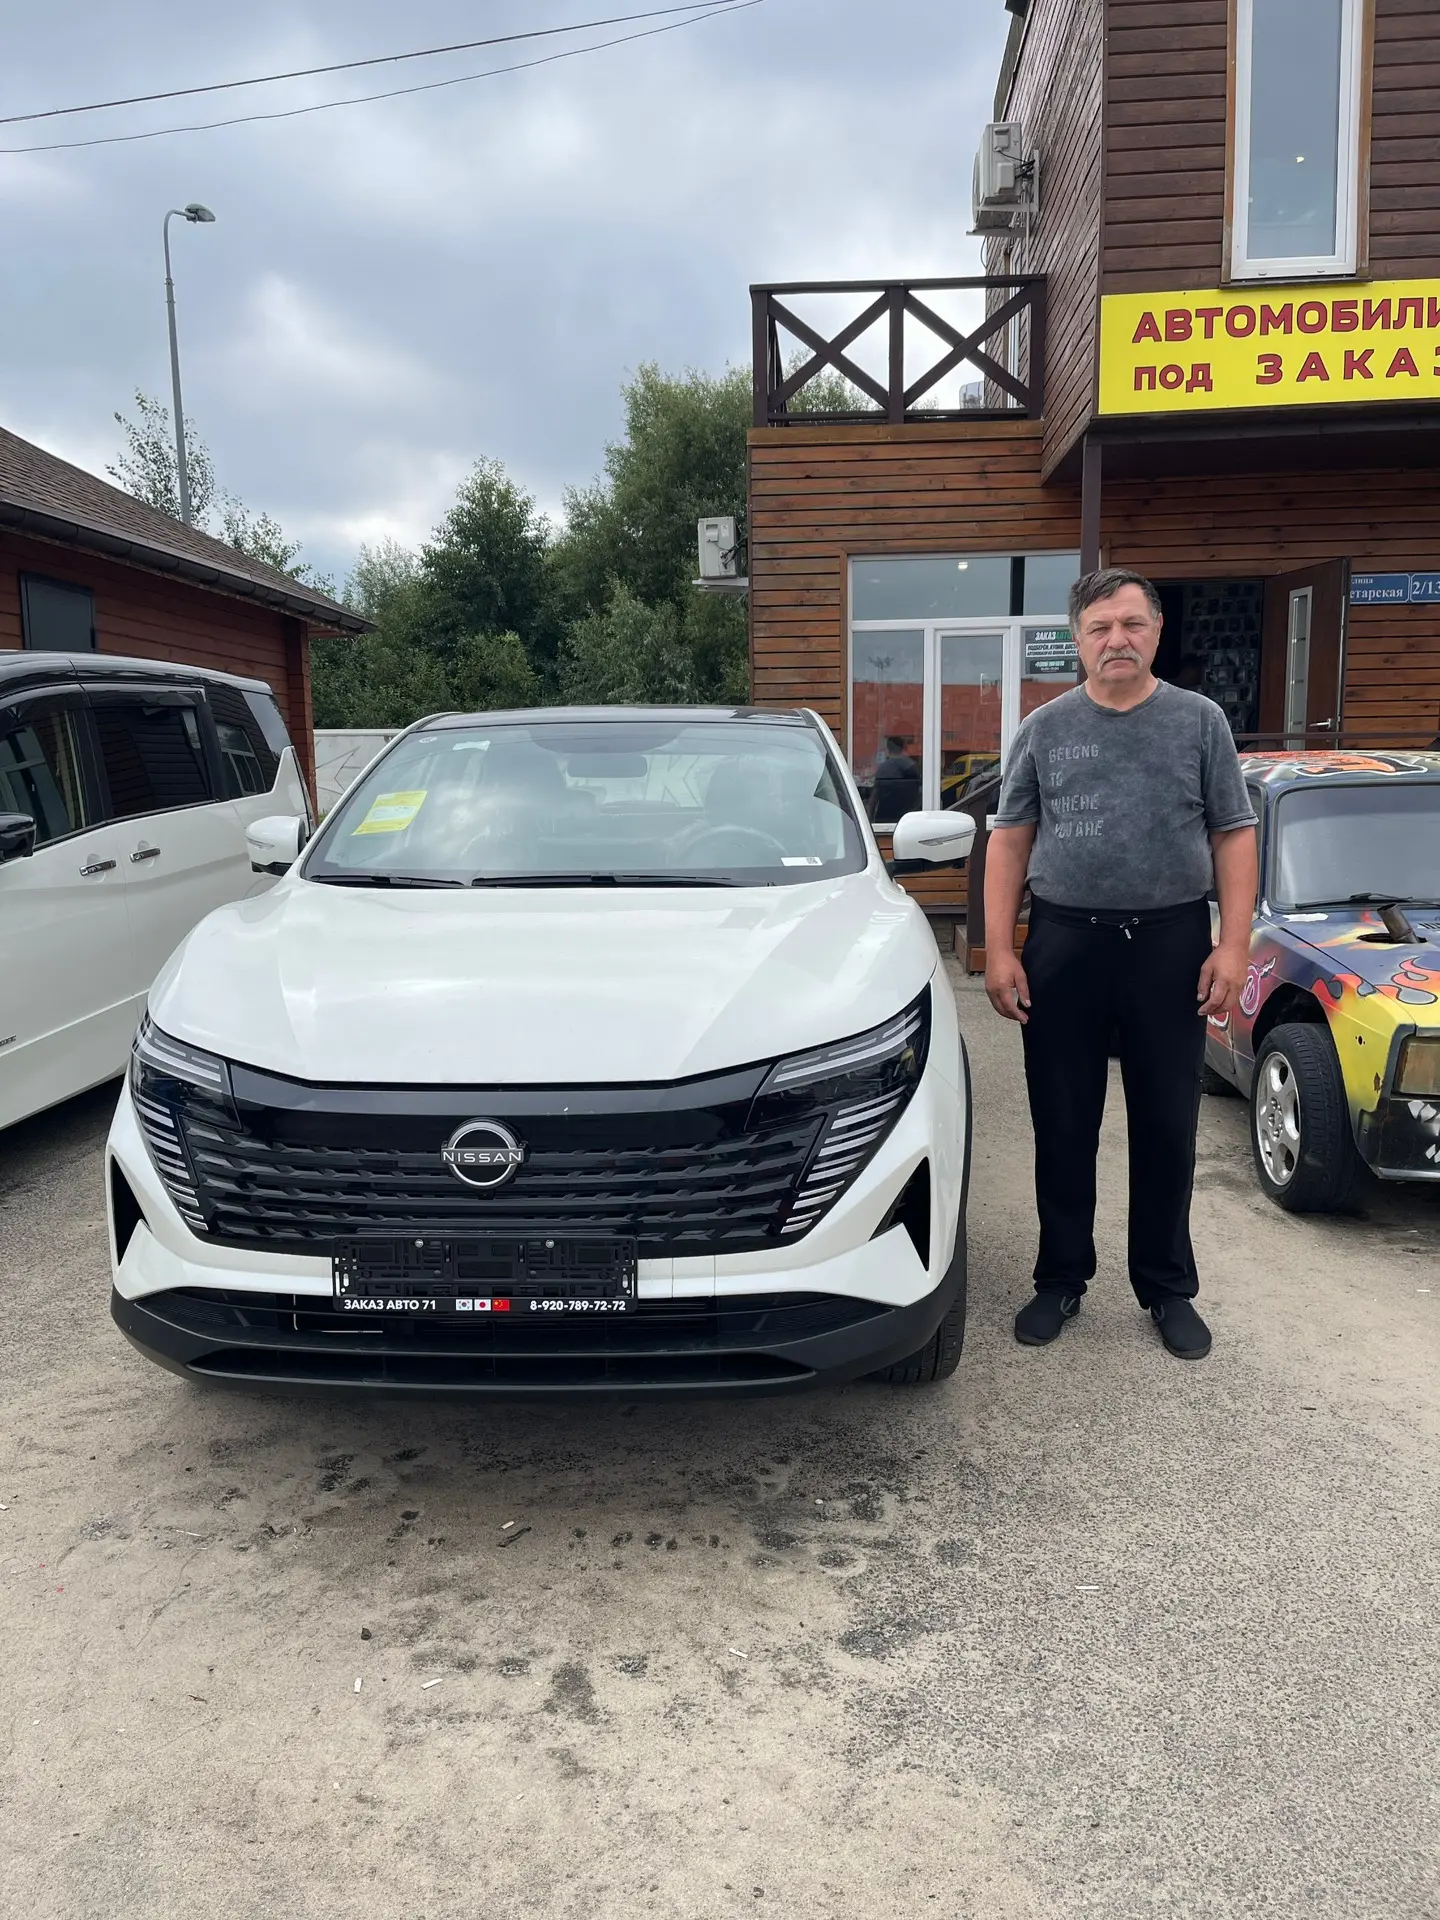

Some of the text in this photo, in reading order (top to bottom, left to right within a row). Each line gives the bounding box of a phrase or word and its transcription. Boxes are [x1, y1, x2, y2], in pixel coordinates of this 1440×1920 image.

[1256, 346, 1440, 385] ЗАКА
[1048, 744, 1099, 763] BELONG
[1049, 771, 1063, 787] TO
[1051, 793, 1100, 814] WHERE
[1055, 819, 1104, 839] YOU ARE
[443, 1151, 521, 1163] NISSAN
[344, 1299, 627, 1311] ЗАКАЗ АВТО 71 8-920-789-72-72
